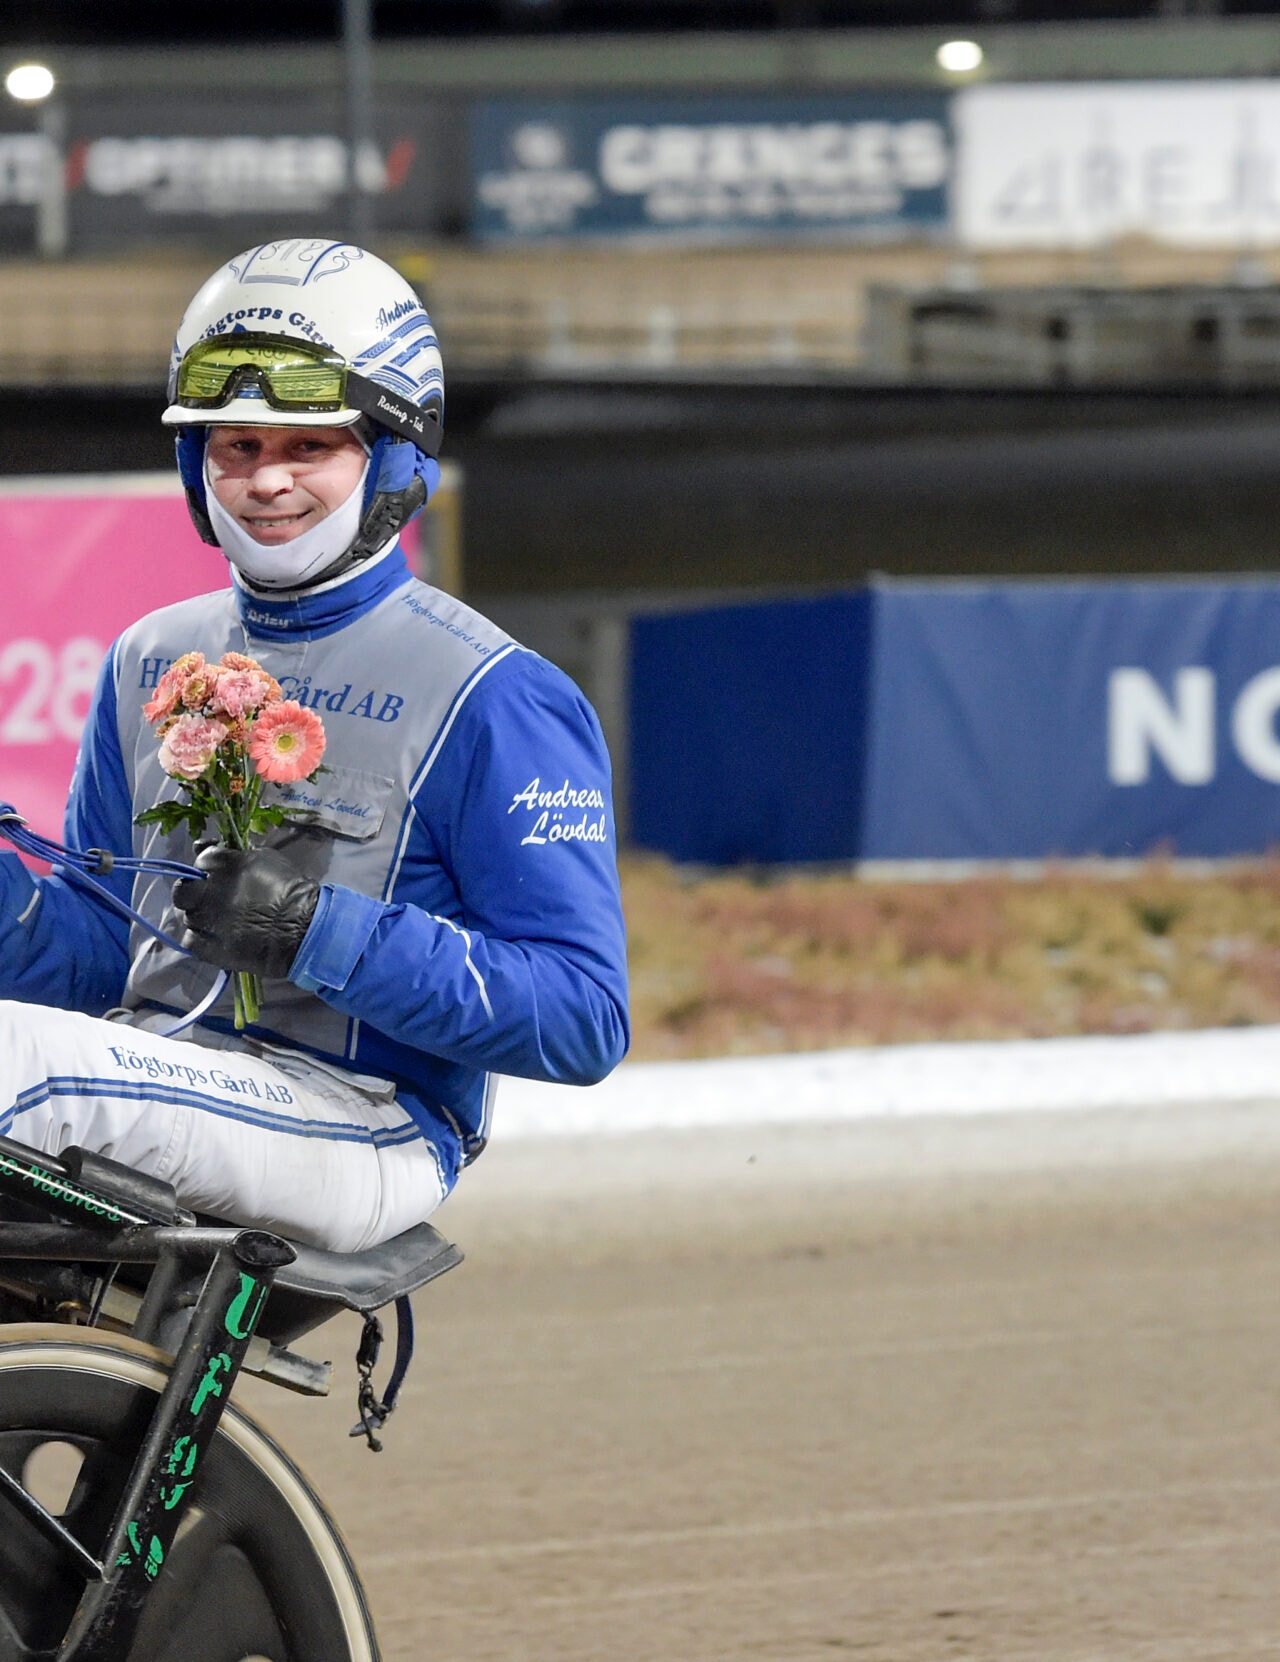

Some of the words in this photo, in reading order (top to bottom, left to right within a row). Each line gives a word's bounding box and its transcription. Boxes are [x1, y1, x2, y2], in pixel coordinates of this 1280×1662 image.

[200, 307, 283, 341] ögtorps
[377, 395, 408, 424] Racing
[402, 594, 446, 627] Högtorps
[446, 623, 475, 643] Gård
[470, 642, 491, 656] AB
[277, 676, 353, 713] Gård
[347, 690, 405, 724] AB
[507, 777, 604, 815] Andreas
[520, 810, 607, 846] Lövdal
[108, 1045, 208, 1087] Högtorps
[209, 1069, 261, 1099] Gård
[265, 1081, 293, 1104] AB
